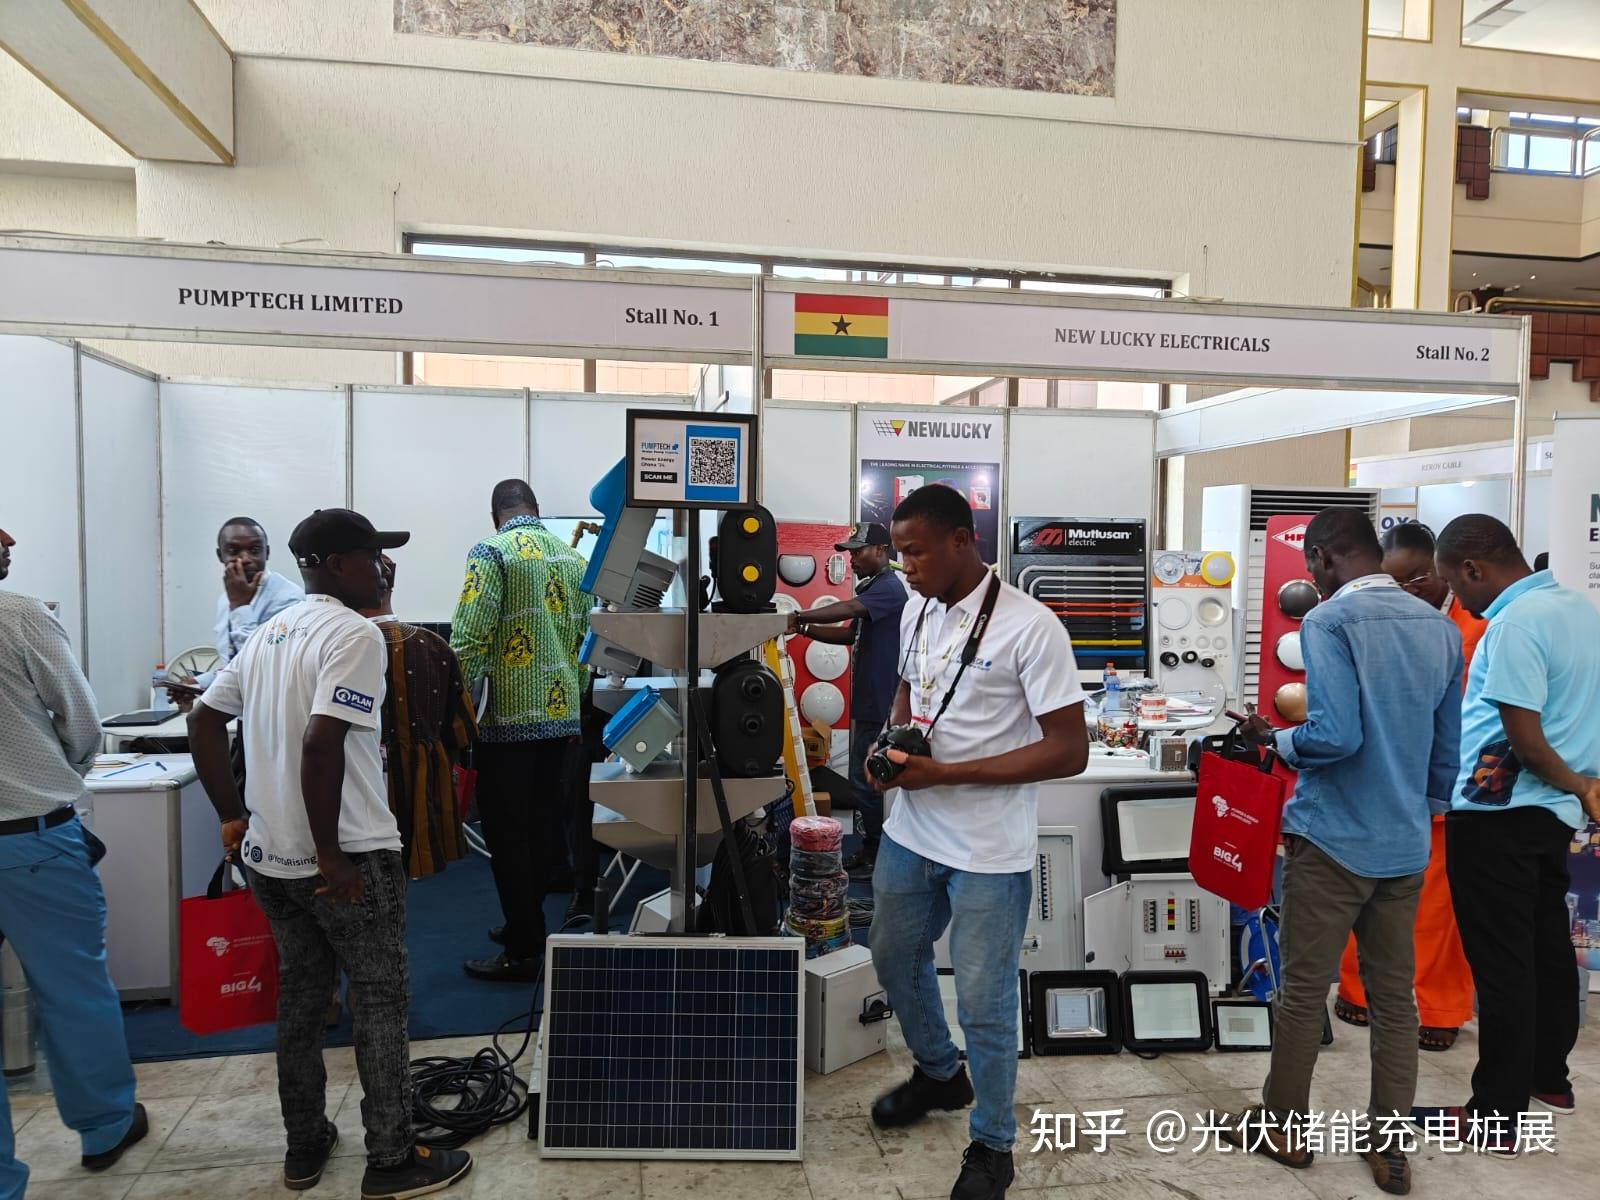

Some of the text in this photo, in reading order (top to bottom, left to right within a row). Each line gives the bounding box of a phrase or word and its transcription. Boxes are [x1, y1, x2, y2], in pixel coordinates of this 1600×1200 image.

[178, 287, 404, 315] PUMPTECH LIMITED
[625, 307, 720, 327] Stall No. 1
[1055, 328, 1271, 353] NEW LUCKY ELECTRICALS
[1416, 344, 1450, 361] Stall
[908, 420, 993, 440] NEWLUCKY
[1068, 539, 1097, 547] electric
[351, 694, 373, 708] PLAN
